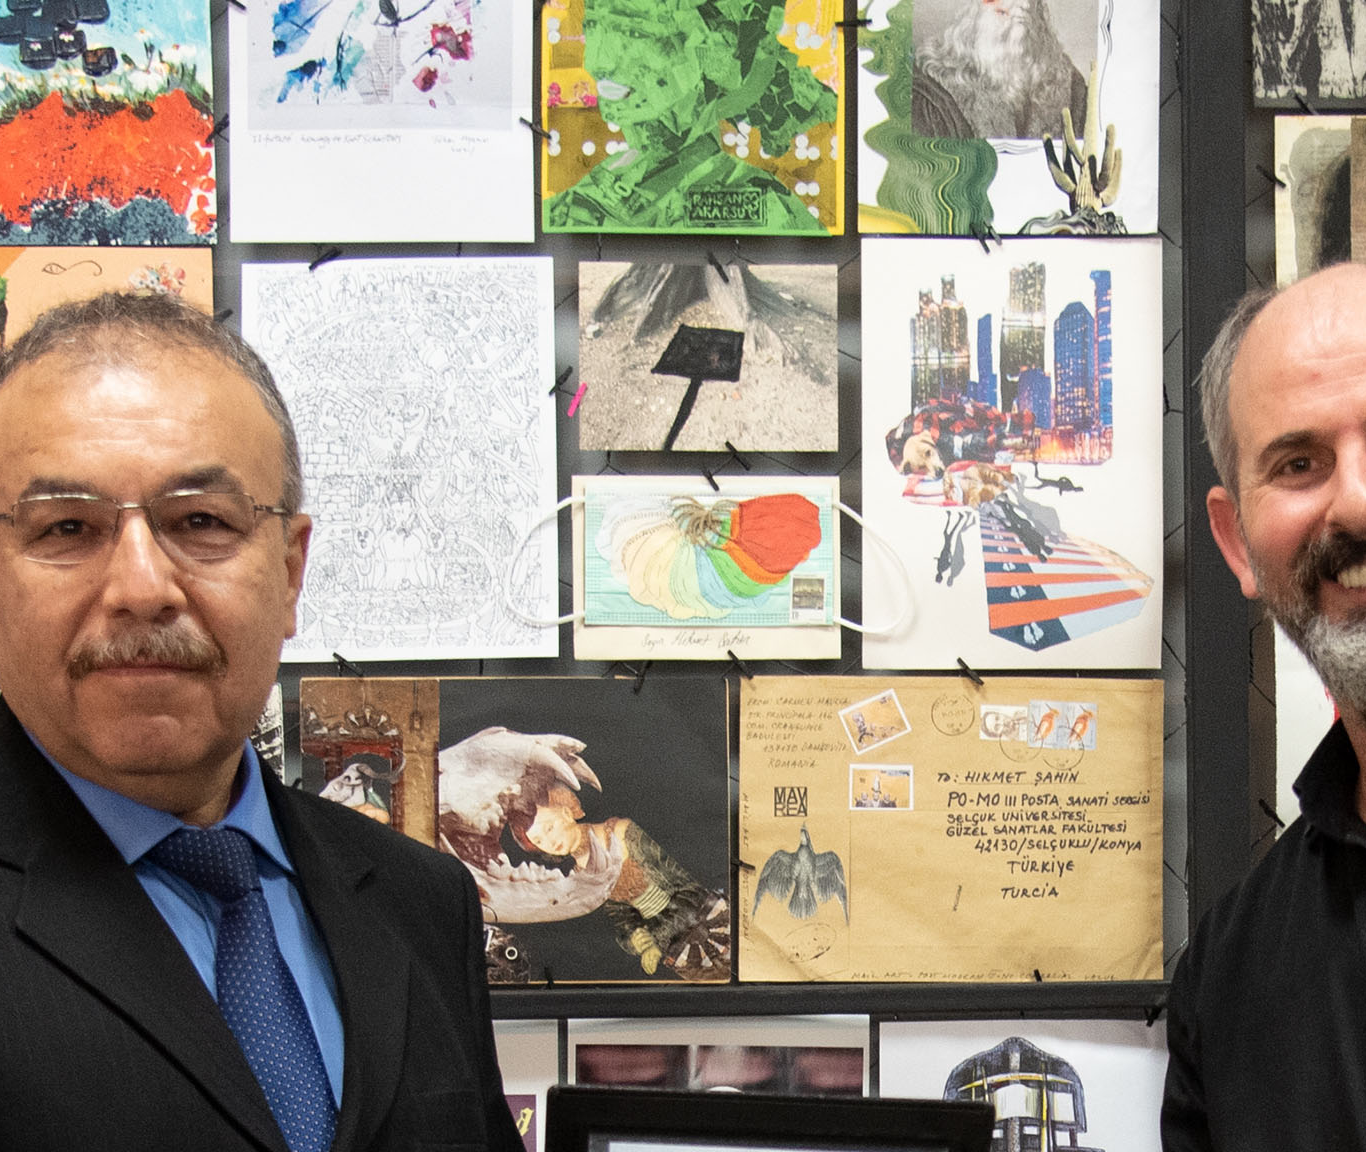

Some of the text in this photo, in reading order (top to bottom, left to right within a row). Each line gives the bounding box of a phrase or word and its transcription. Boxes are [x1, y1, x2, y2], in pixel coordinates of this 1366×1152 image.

[965, 771, 1026, 783] HIKMET
[1022, 793, 1059, 806] POSTA
[947, 813, 995, 826] SELÇUK
[946, 823, 988, 837] GÜZEL
[994, 825, 1057, 835] SANATLAR
